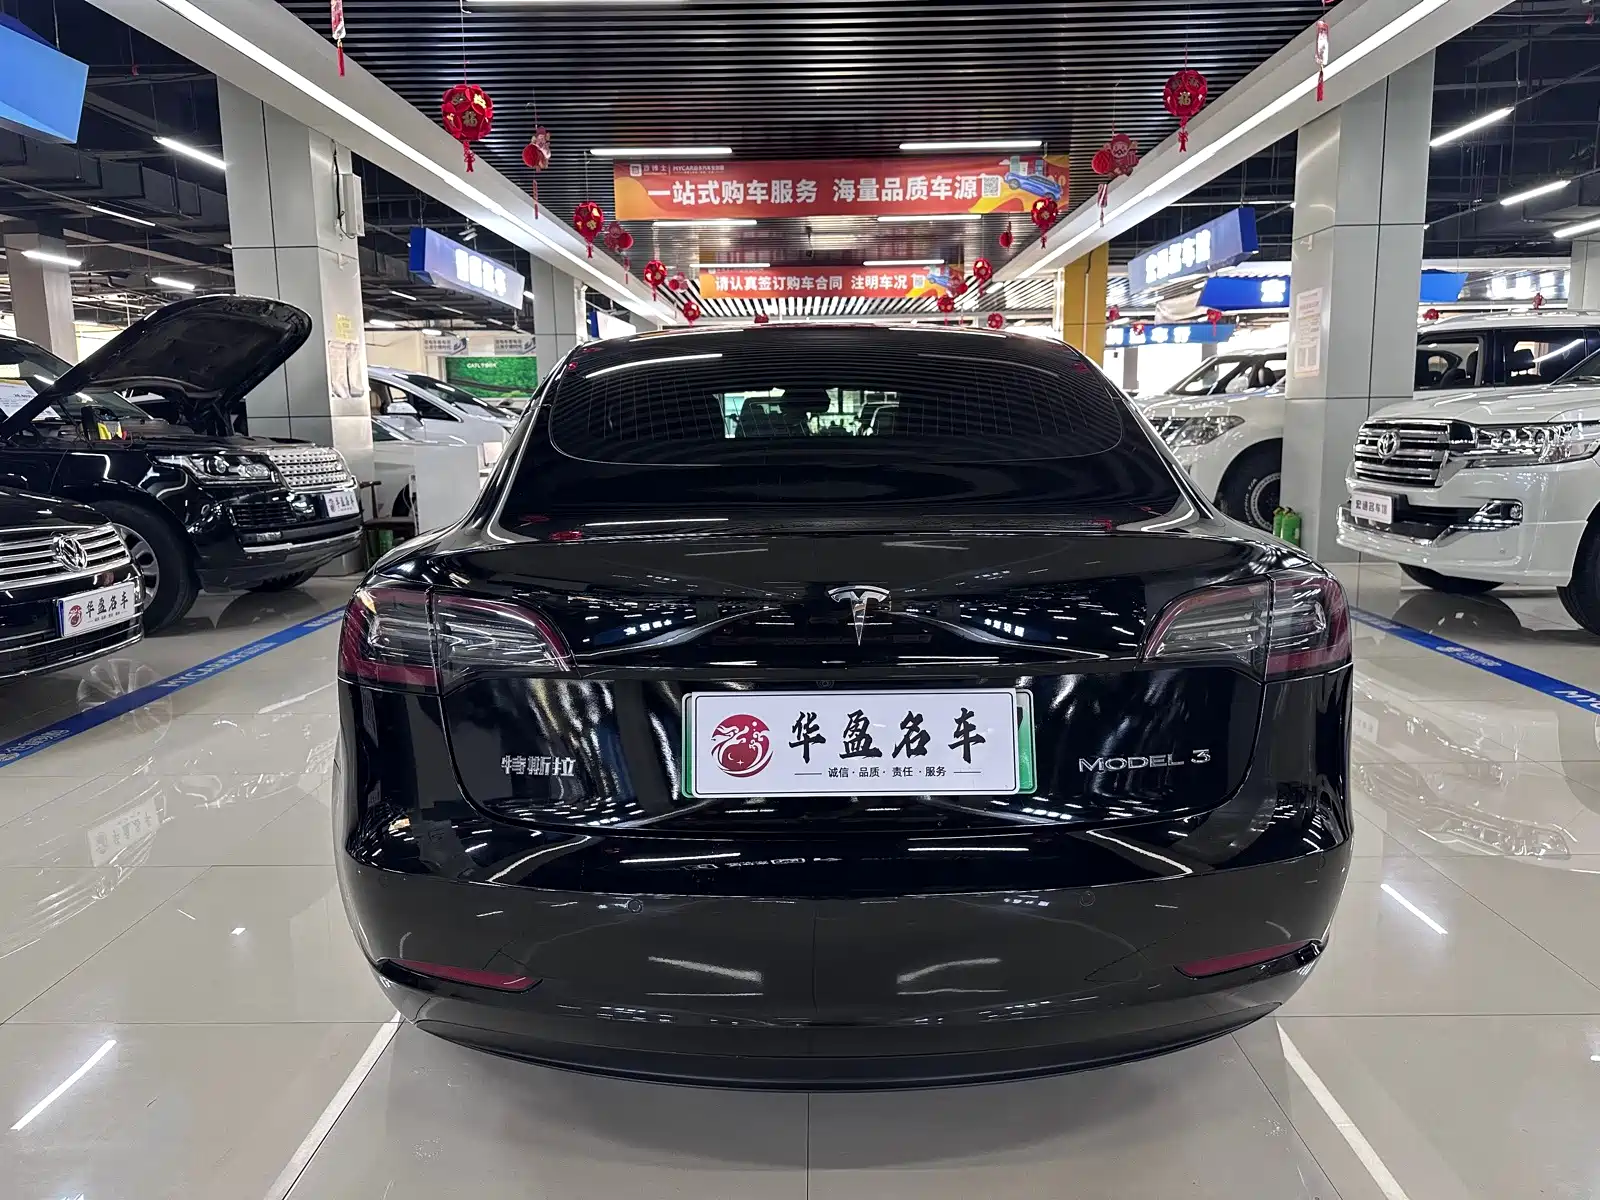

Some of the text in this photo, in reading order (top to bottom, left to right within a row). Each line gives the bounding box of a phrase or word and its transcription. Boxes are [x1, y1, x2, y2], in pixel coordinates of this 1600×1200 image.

[648, 175, 979, 205] 一站式购车服务 海量品质车源
[715, 274, 908, 291] 请认真签订购车合同 注明车况
[788, 707, 986, 764] 华盈名车
[500, 754, 577, 777] 特斯拉
[1078, 748, 1211, 773] MODEL 3
